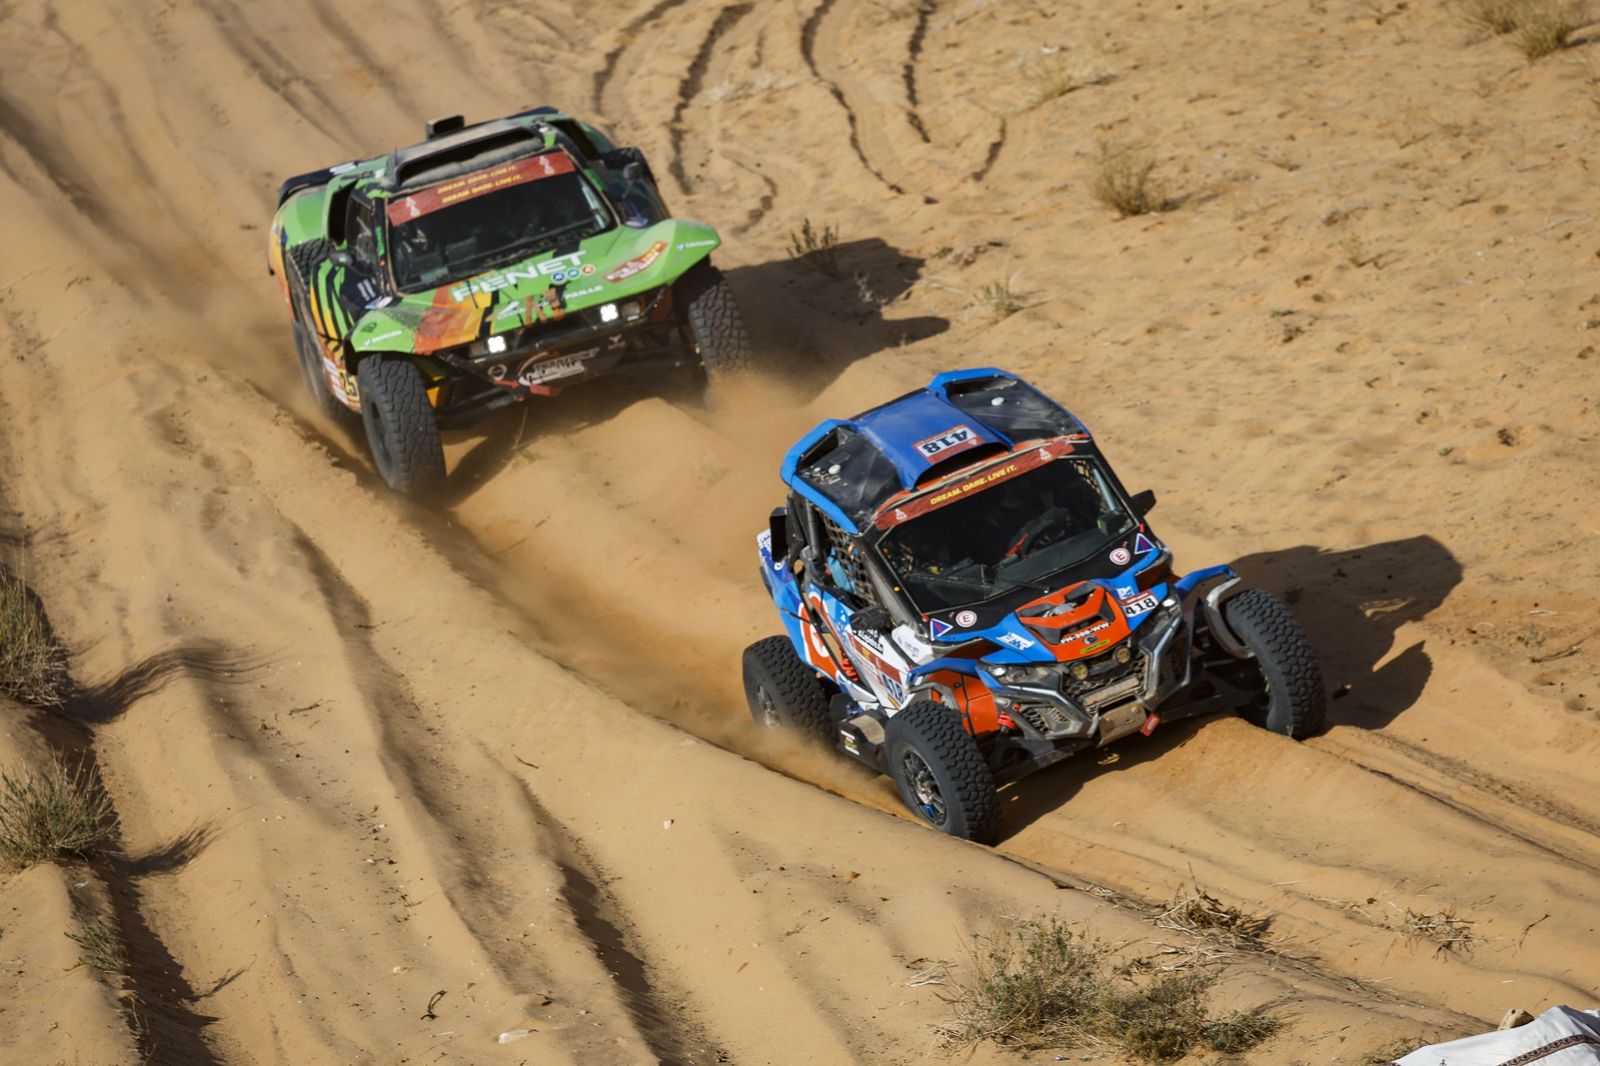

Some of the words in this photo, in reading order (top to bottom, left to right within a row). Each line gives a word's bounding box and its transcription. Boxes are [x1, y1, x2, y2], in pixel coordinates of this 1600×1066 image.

[922, 431, 969, 454] 418
[930, 488, 962, 506] DREAM.
[962, 478, 988, 493] DARE.
[988, 468, 1006, 482] LIVE
[1006, 463, 1018, 475] IT.
[1125, 597, 1156, 615] 418
